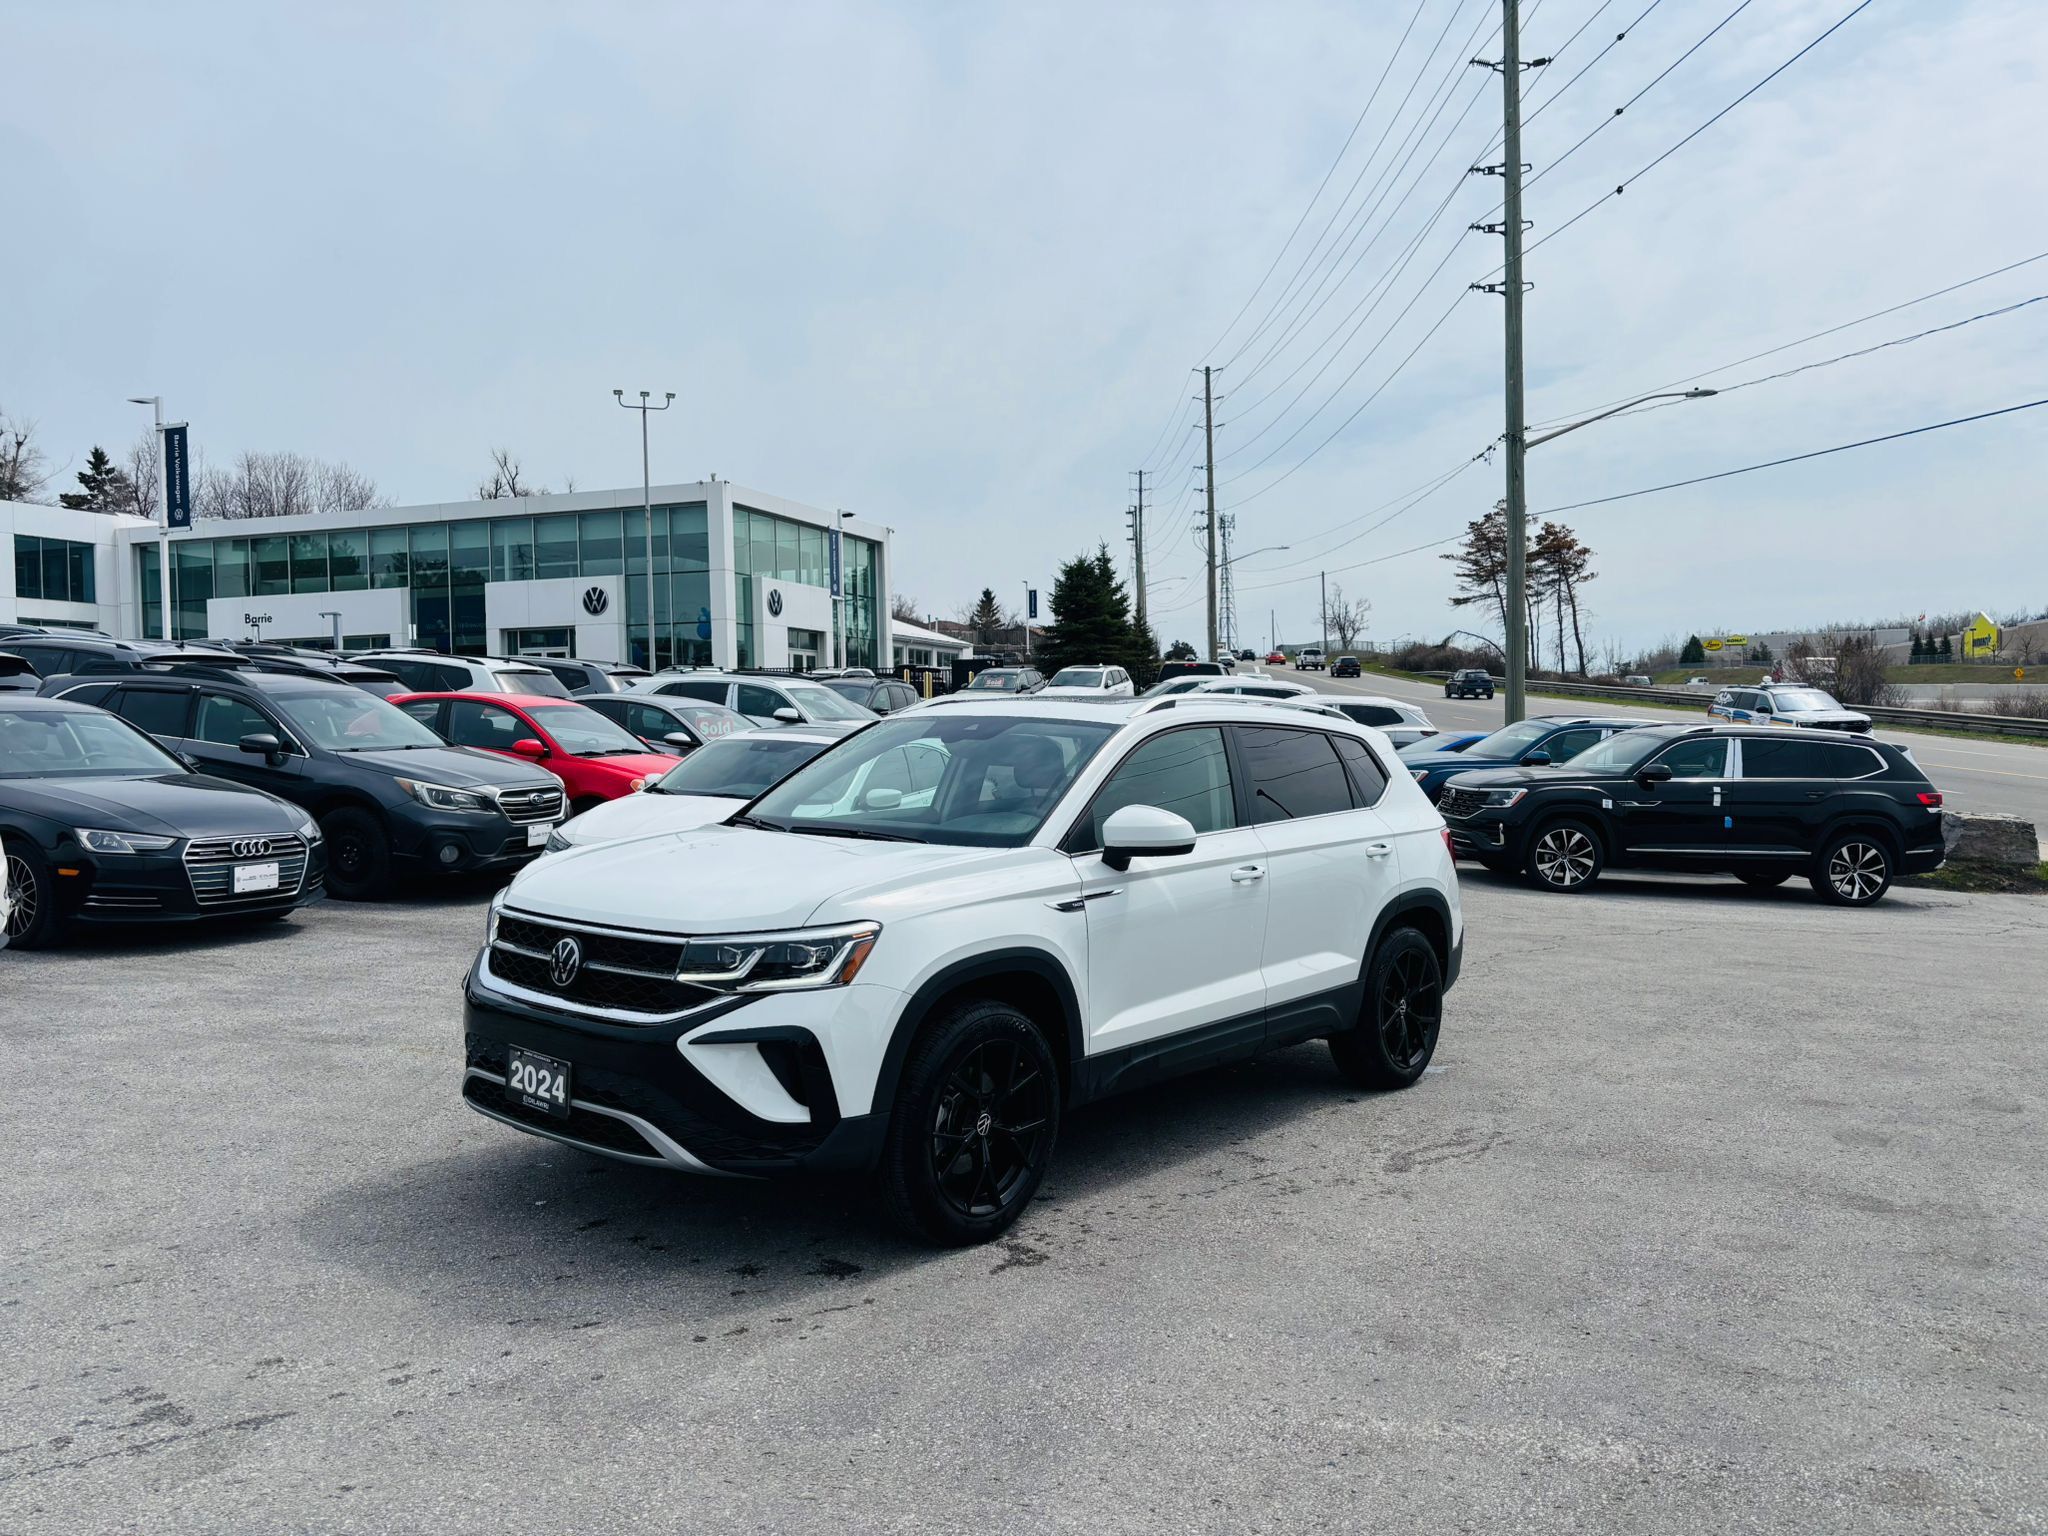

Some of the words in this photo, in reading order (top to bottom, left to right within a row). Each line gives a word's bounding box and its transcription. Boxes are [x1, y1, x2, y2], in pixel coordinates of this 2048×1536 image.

[244, 613, 273, 624] Barrie
[700, 721, 731, 735] Sold
[510, 1060, 565, 1103] 2024
